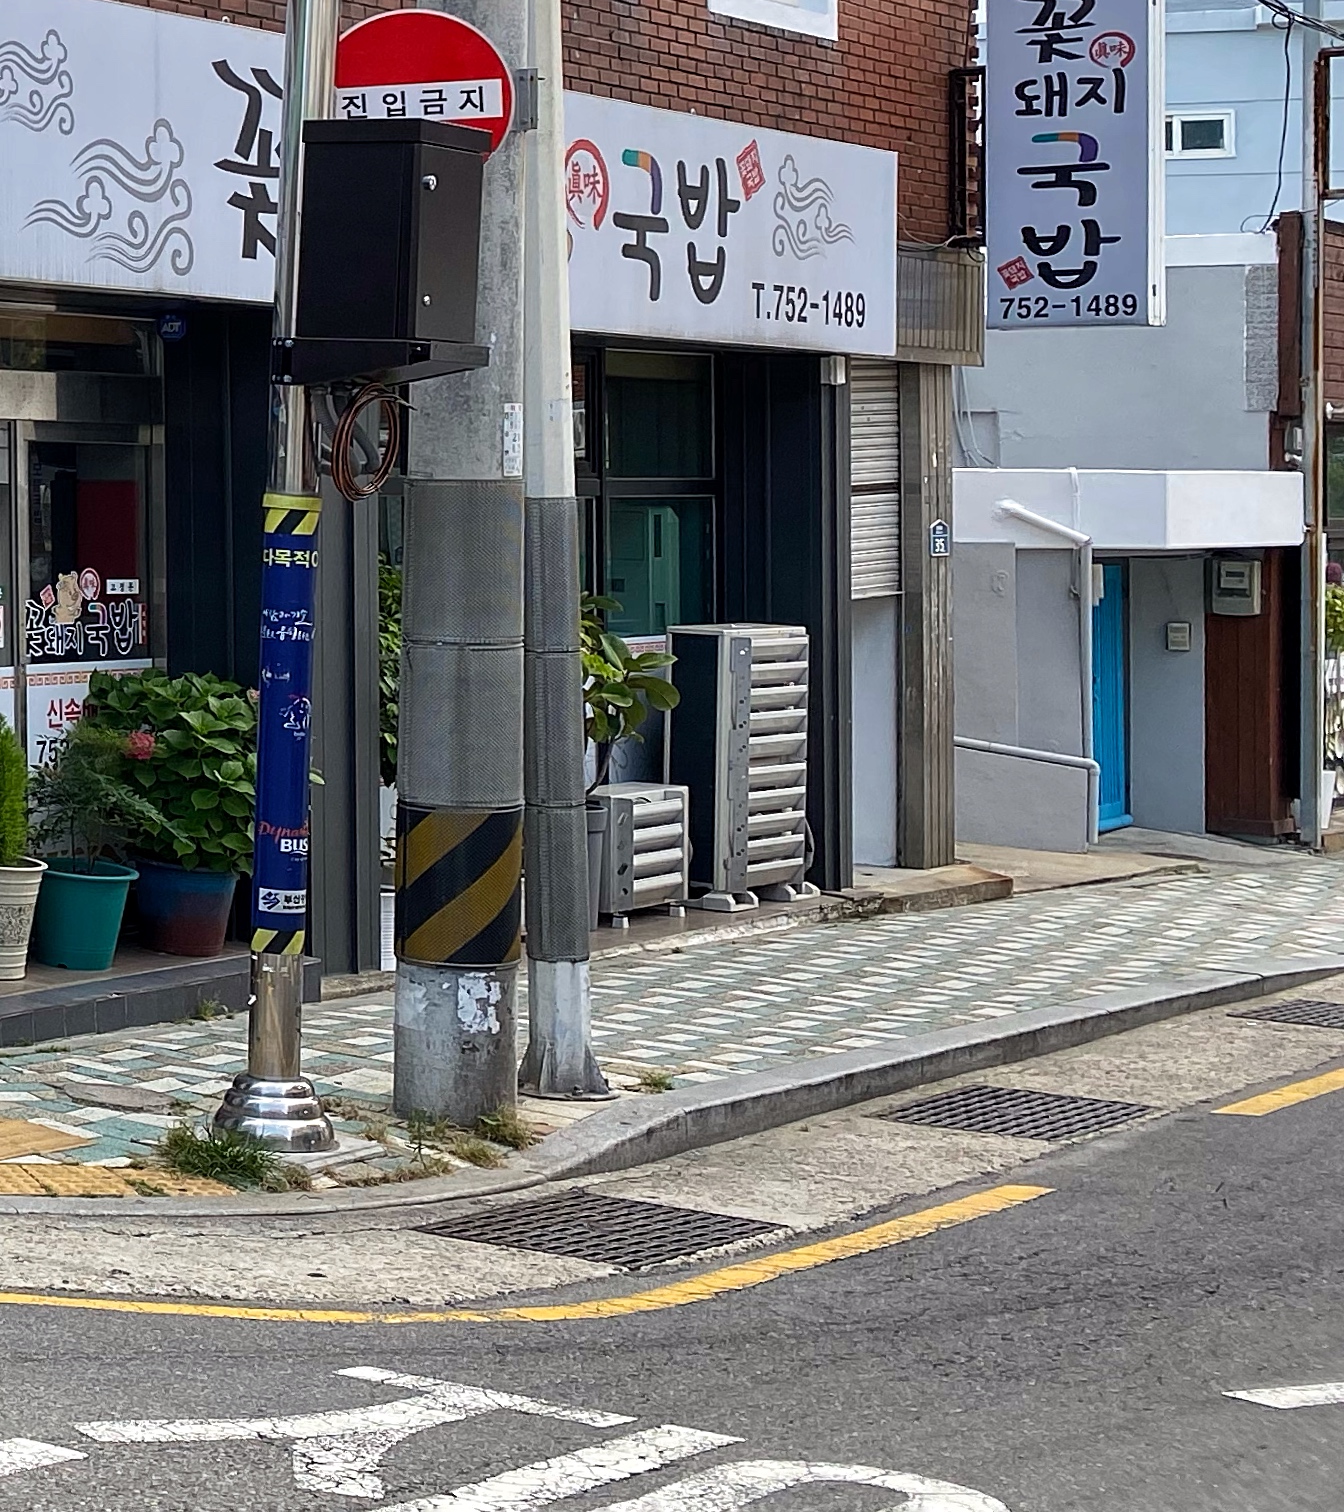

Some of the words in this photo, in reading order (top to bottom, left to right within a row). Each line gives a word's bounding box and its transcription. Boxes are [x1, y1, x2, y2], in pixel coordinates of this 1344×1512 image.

[341, 85, 486, 119] 진입금지
[613, 148, 741, 305] 국밥
[751, 282, 866, 329] T.752-1489
[1000, 294, 1138, 320] 752-1489
